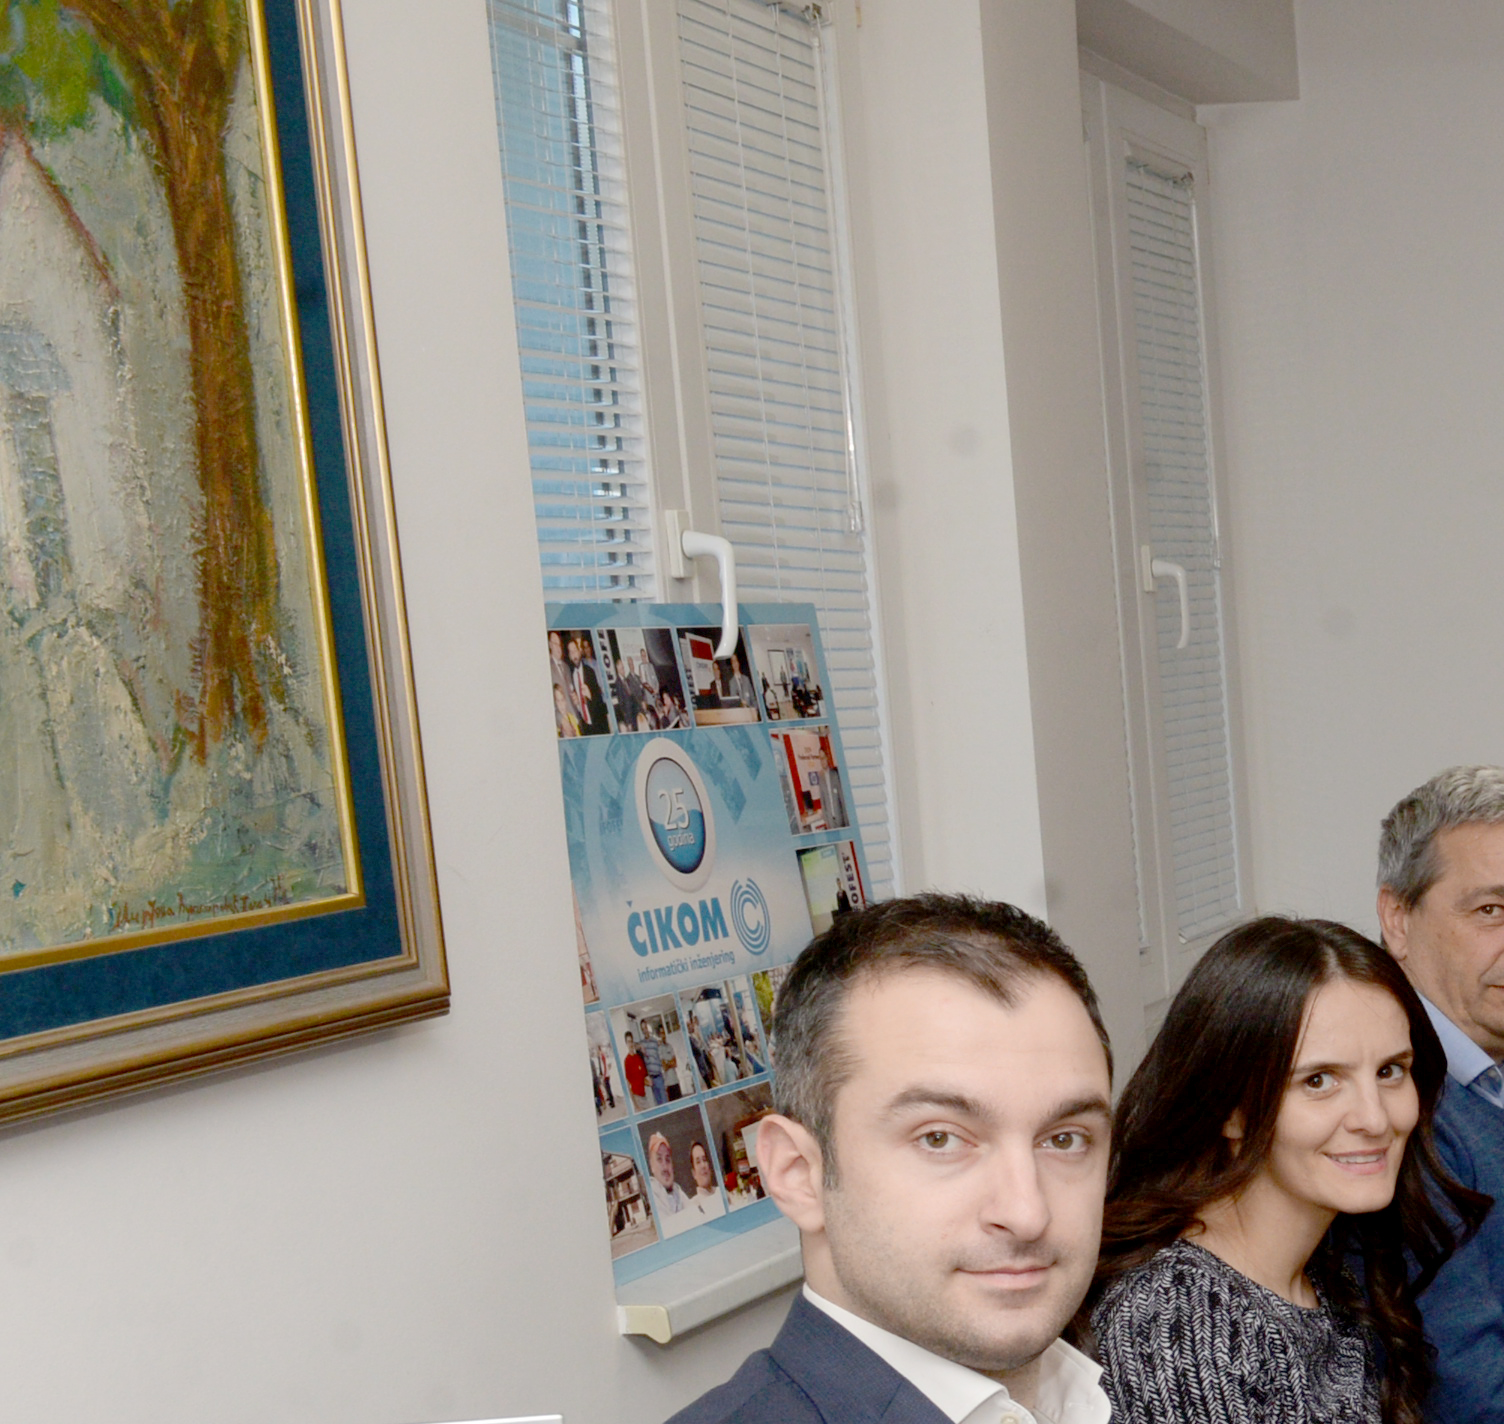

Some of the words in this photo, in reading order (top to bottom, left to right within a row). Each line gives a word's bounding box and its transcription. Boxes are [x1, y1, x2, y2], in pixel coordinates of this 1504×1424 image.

[659, 788, 691, 831] 25
[667, 832, 696, 851] godina
[627, 897, 730, 957] ČIKOM
[637, 957, 689, 983] informatički
[690, 950, 736, 972] inženjering
